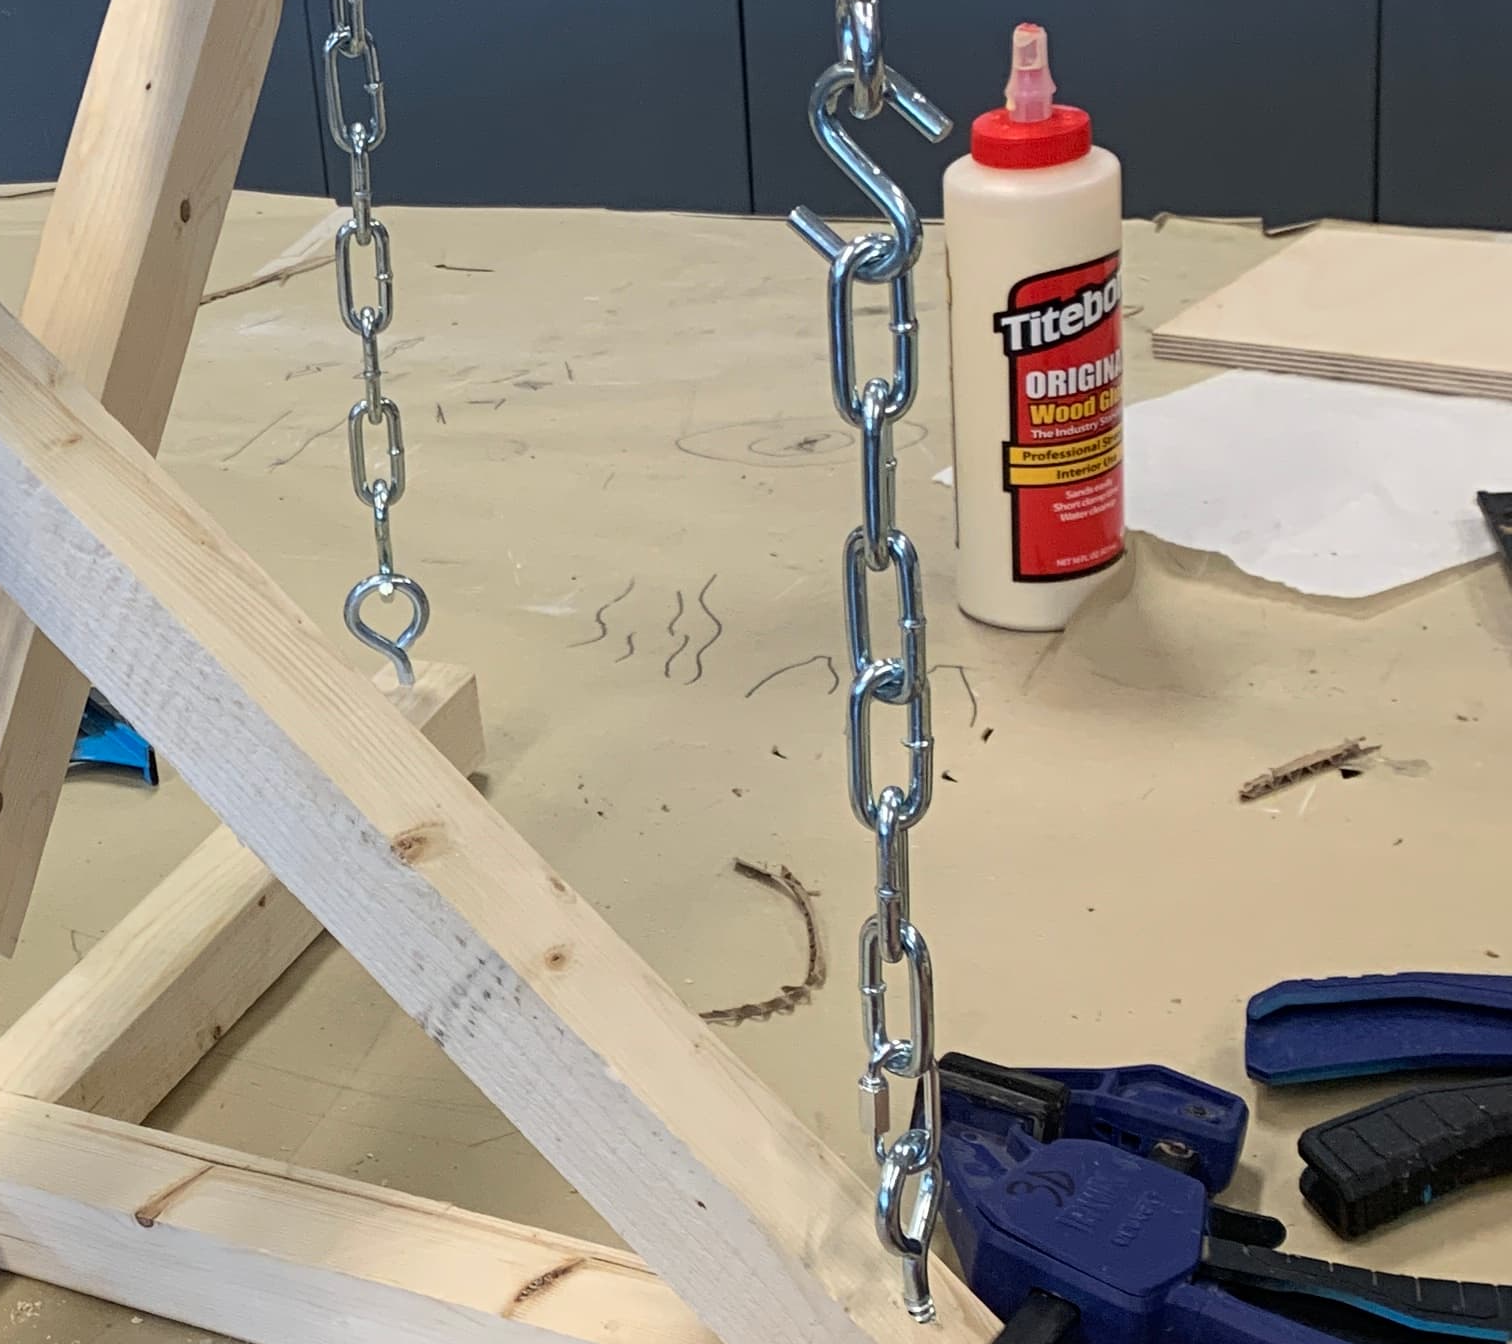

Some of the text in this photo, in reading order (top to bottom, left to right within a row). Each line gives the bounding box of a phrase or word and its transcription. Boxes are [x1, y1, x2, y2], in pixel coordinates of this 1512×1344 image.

[1029, 395, 1096, 426] Wood
[1031, 429, 1054, 440] The
[1055, 419, 1099, 438] Industry
[1022, 440, 1101, 462] Professional
[1056, 462, 1101, 480] Interior
